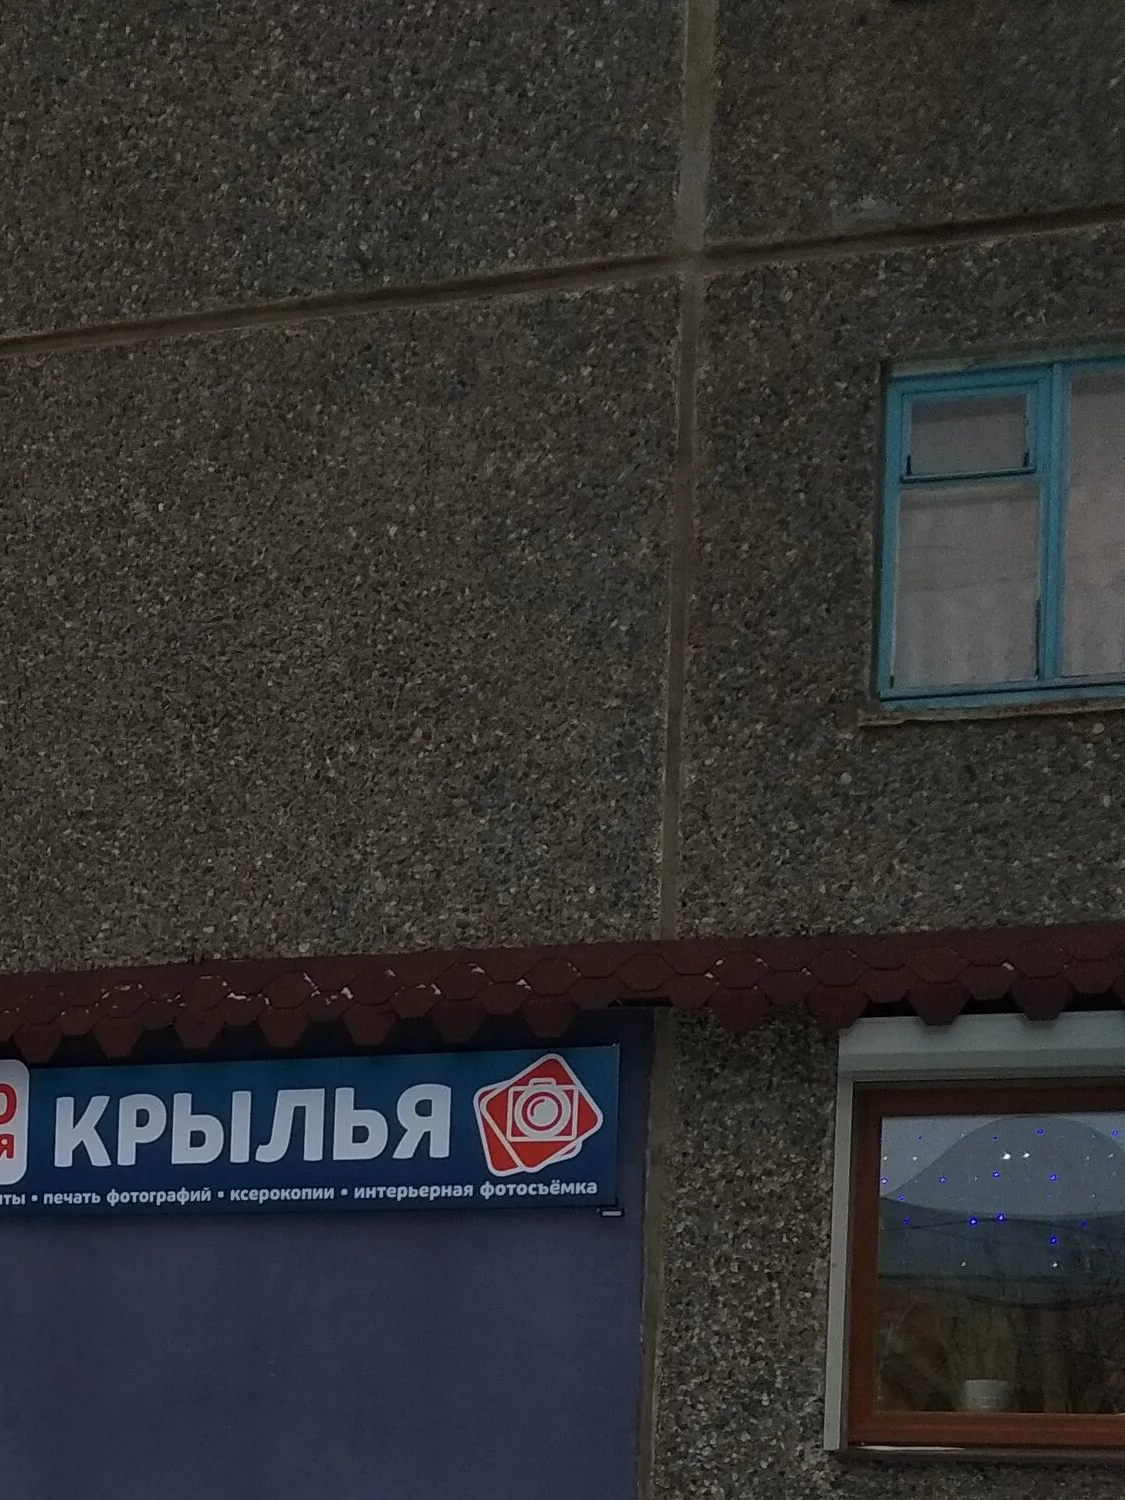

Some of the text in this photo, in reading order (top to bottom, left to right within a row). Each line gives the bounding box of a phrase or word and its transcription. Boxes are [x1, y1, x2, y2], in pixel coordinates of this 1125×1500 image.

[53, 1083, 452, 1169] КРЫЛЬЯ
[42, 1190, 102, 1206] печать
[105, 1187, 213, 1207] фотографий
[229, 1186, 335, 1205] ксерокопии
[354, 1182, 475, 1203] интерьерная
[479, 1179, 599, 1201] фотосъёмка
